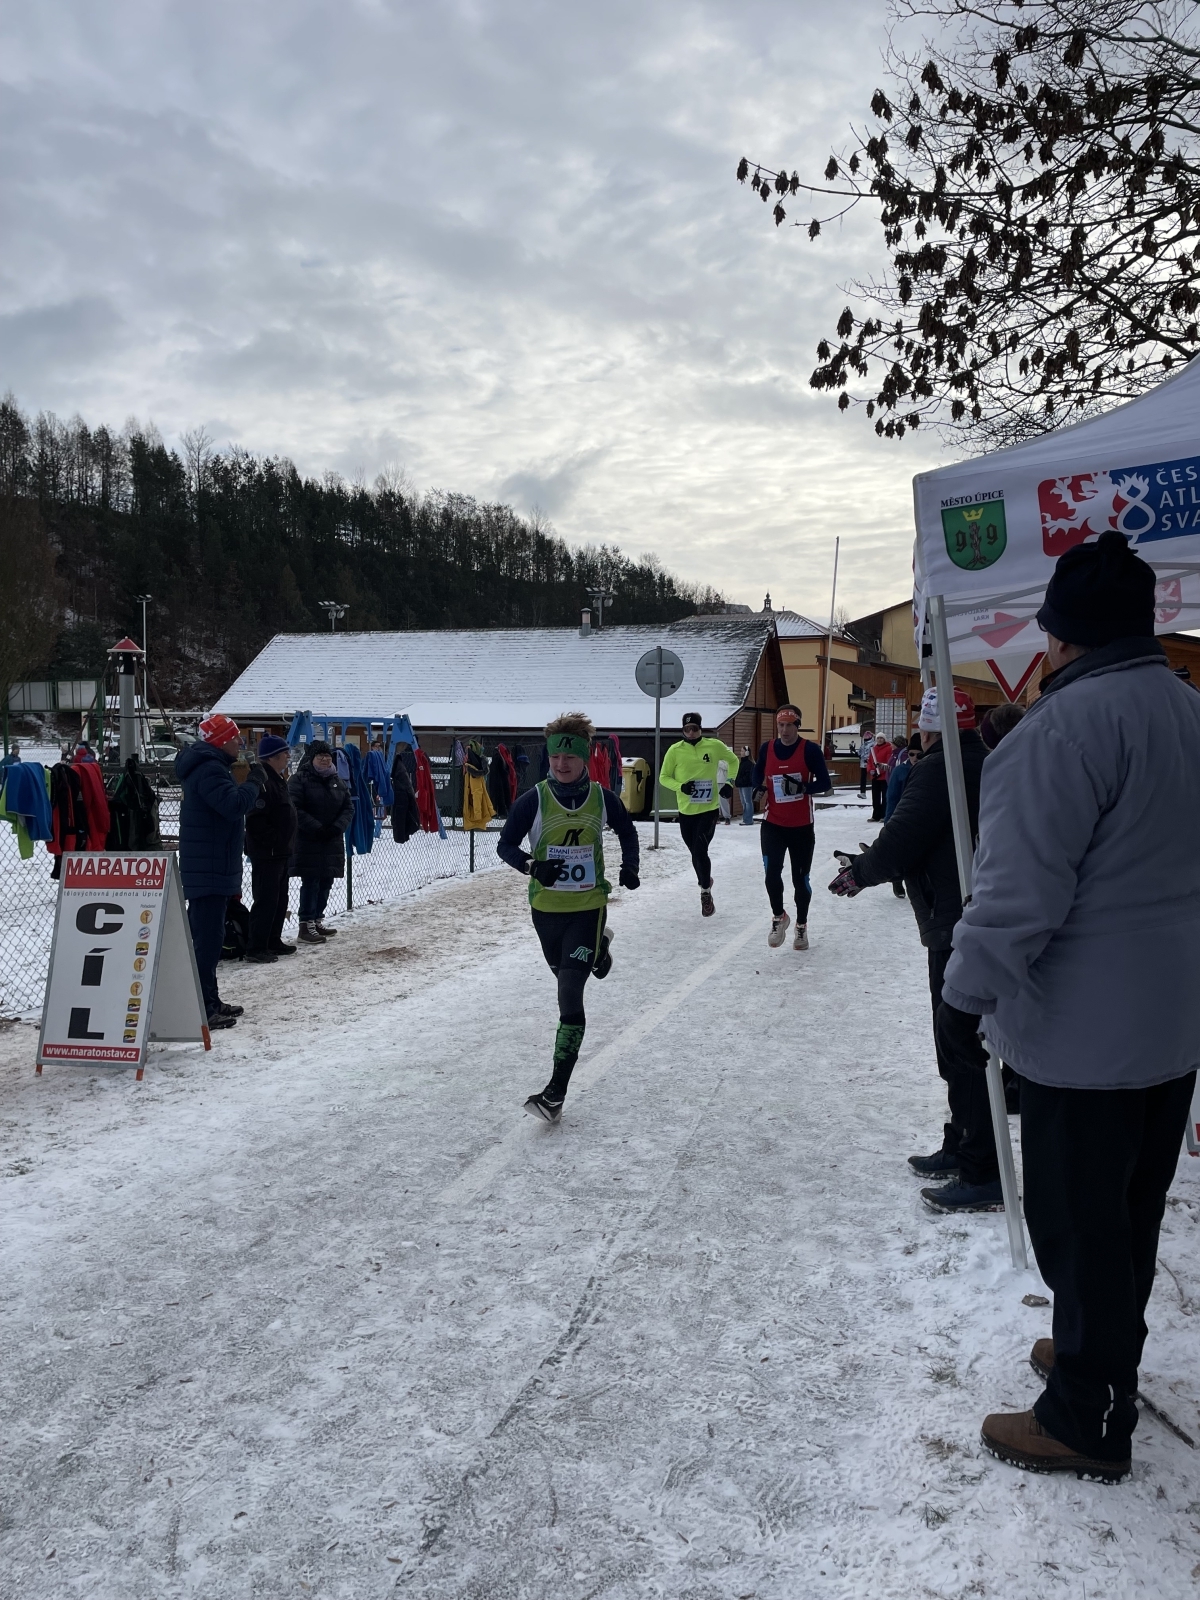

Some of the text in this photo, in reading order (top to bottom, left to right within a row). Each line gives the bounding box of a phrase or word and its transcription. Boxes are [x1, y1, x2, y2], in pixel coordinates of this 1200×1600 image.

[974, 489, 1005, 502] ÚPICE
[691, 788, 712, 799] 277
[65, 858, 167, 876] MARATON
[557, 864, 586, 882] 50
[135, 877, 161, 886] stav
[46, 1046, 137, 1060] www.maratonstav.cz
